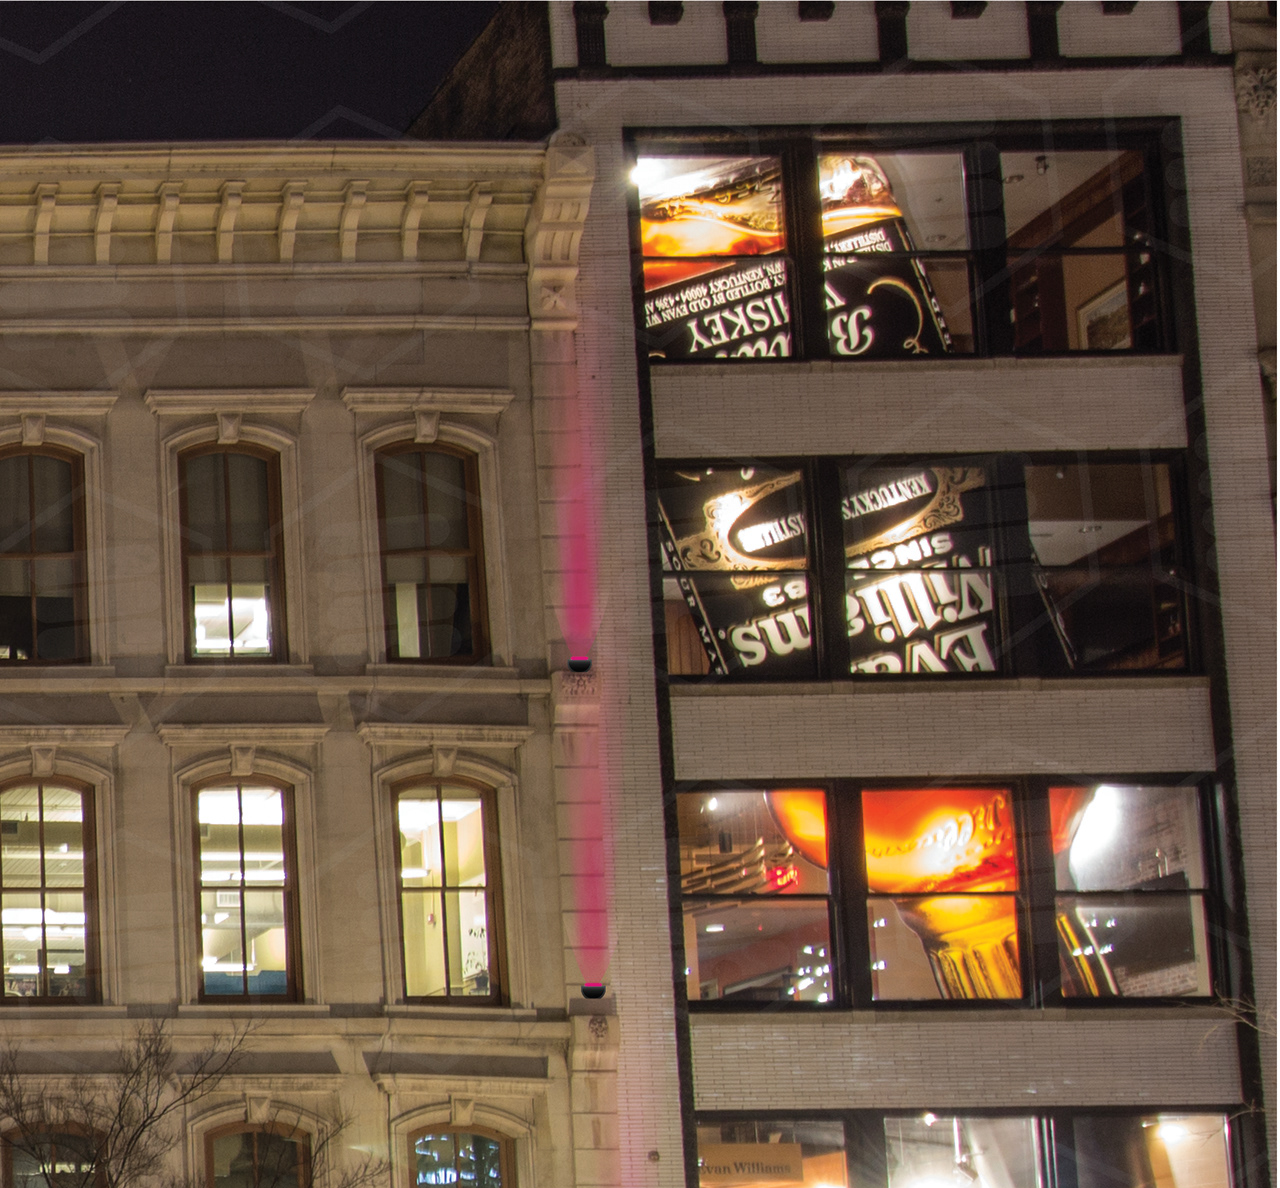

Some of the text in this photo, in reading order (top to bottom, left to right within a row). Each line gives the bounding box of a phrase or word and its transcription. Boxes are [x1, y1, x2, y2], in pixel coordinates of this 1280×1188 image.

[726, 279, 771, 301] BOTTLED
[689, 295, 711, 313] OLD
[712, 293, 726, 307] BY
[662, 303, 689, 322] EVAN
[842, 472, 932, 520] KENTUCKY'S
[732, 1161, 791, 1175] Williams
